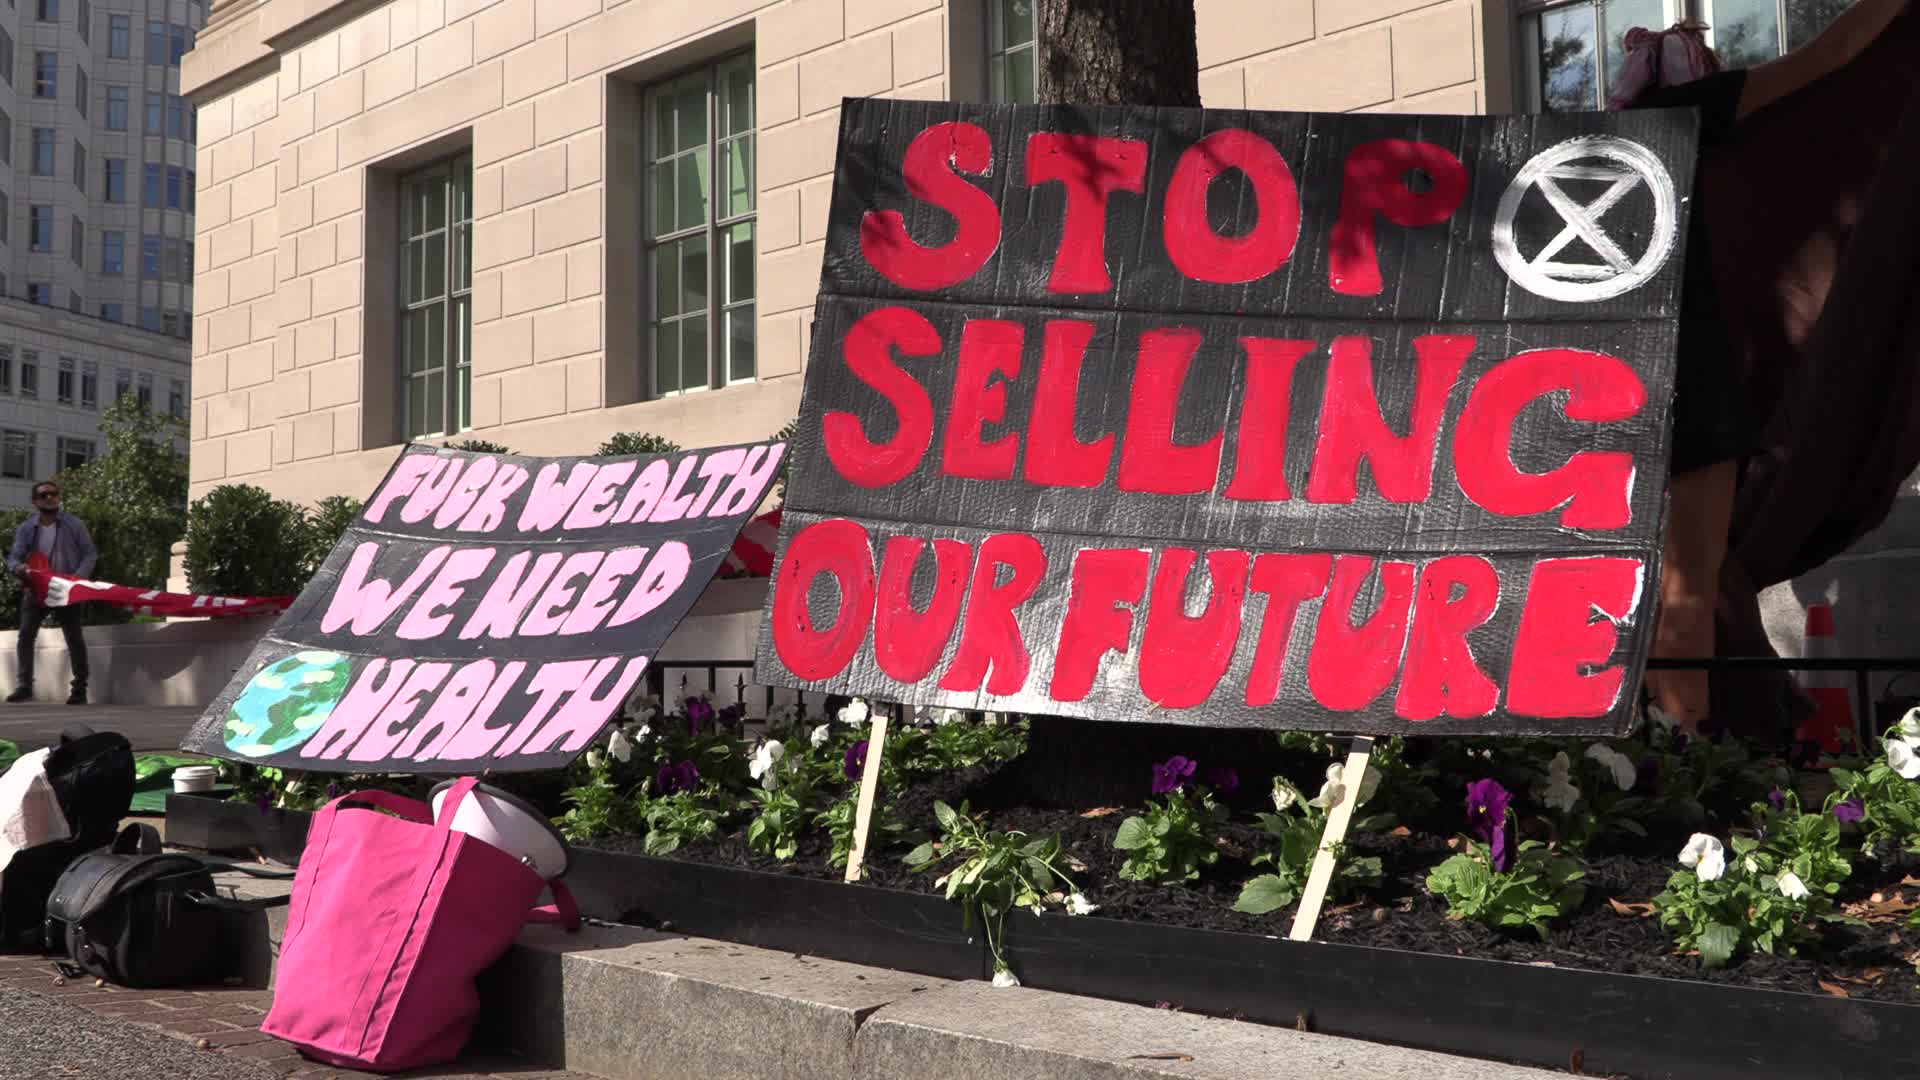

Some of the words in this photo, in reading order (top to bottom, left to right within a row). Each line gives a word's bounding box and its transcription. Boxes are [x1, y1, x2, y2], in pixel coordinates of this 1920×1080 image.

[861, 121, 1468, 296] STOP
[364, 452, 529, 532] FUCK
[517, 442, 786, 532] WEALTH
[822, 305, 1649, 531] SELLING
[320, 541, 497, 640] WE
[460, 541, 692, 640] NEED
[771, 517, 1049, 698] OUR
[1050, 547, 1646, 721] FUTURE
[299, 655, 648, 762] HEALTH
